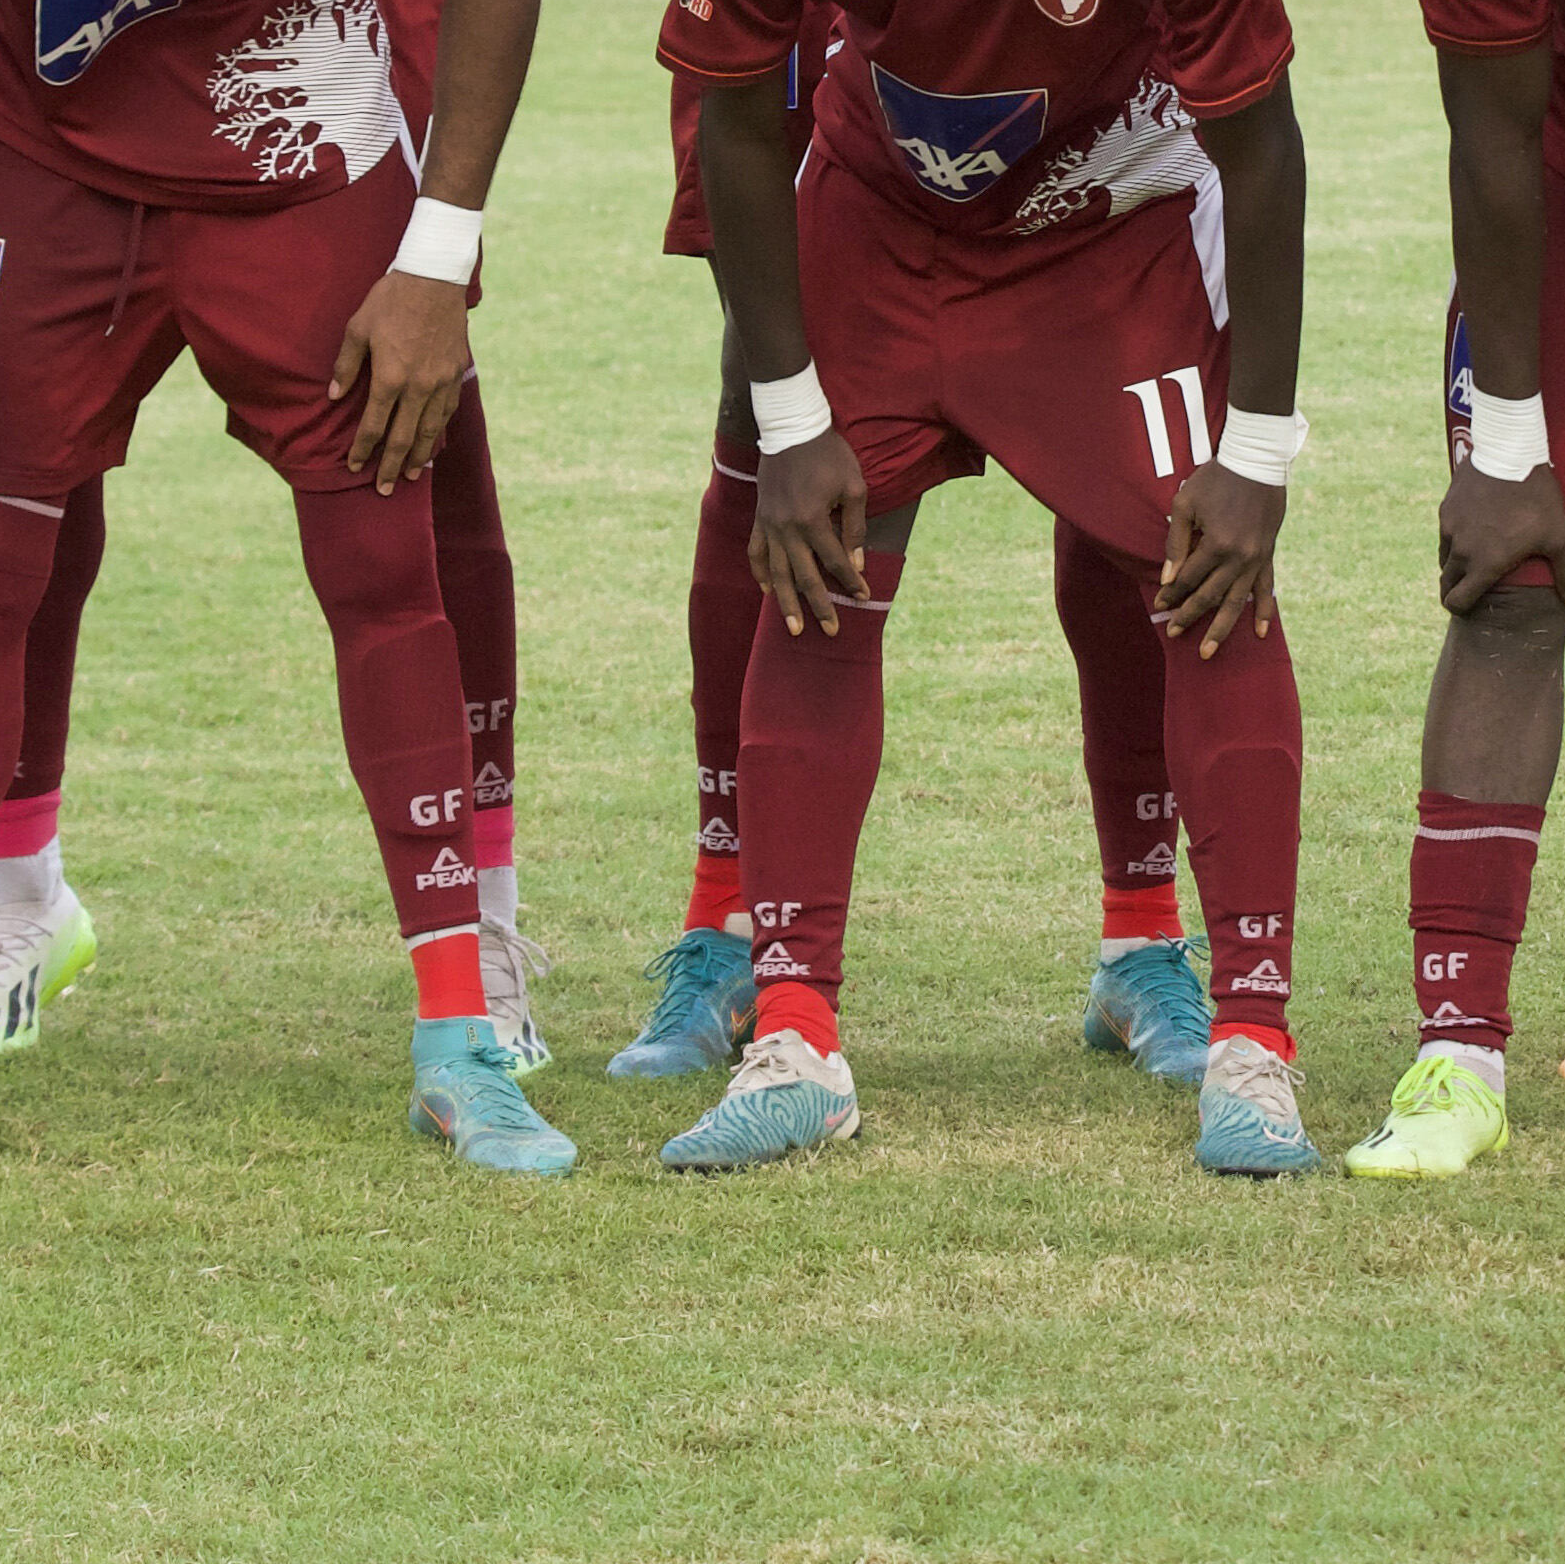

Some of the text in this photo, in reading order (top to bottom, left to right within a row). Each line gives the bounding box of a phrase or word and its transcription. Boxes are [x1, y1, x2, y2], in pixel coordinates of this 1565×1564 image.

[894, 137, 1009, 190] AXA
[1122, 366, 1212, 478] 11
[466, 697, 509, 734] GF
[410, 787, 464, 826] GF
[416, 864, 477, 891] PEAK
[754, 901, 802, 928] GF
[1239, 913, 1284, 939] GF
[753, 960, 811, 977] PEAK
[1423, 952, 1469, 982] GF
